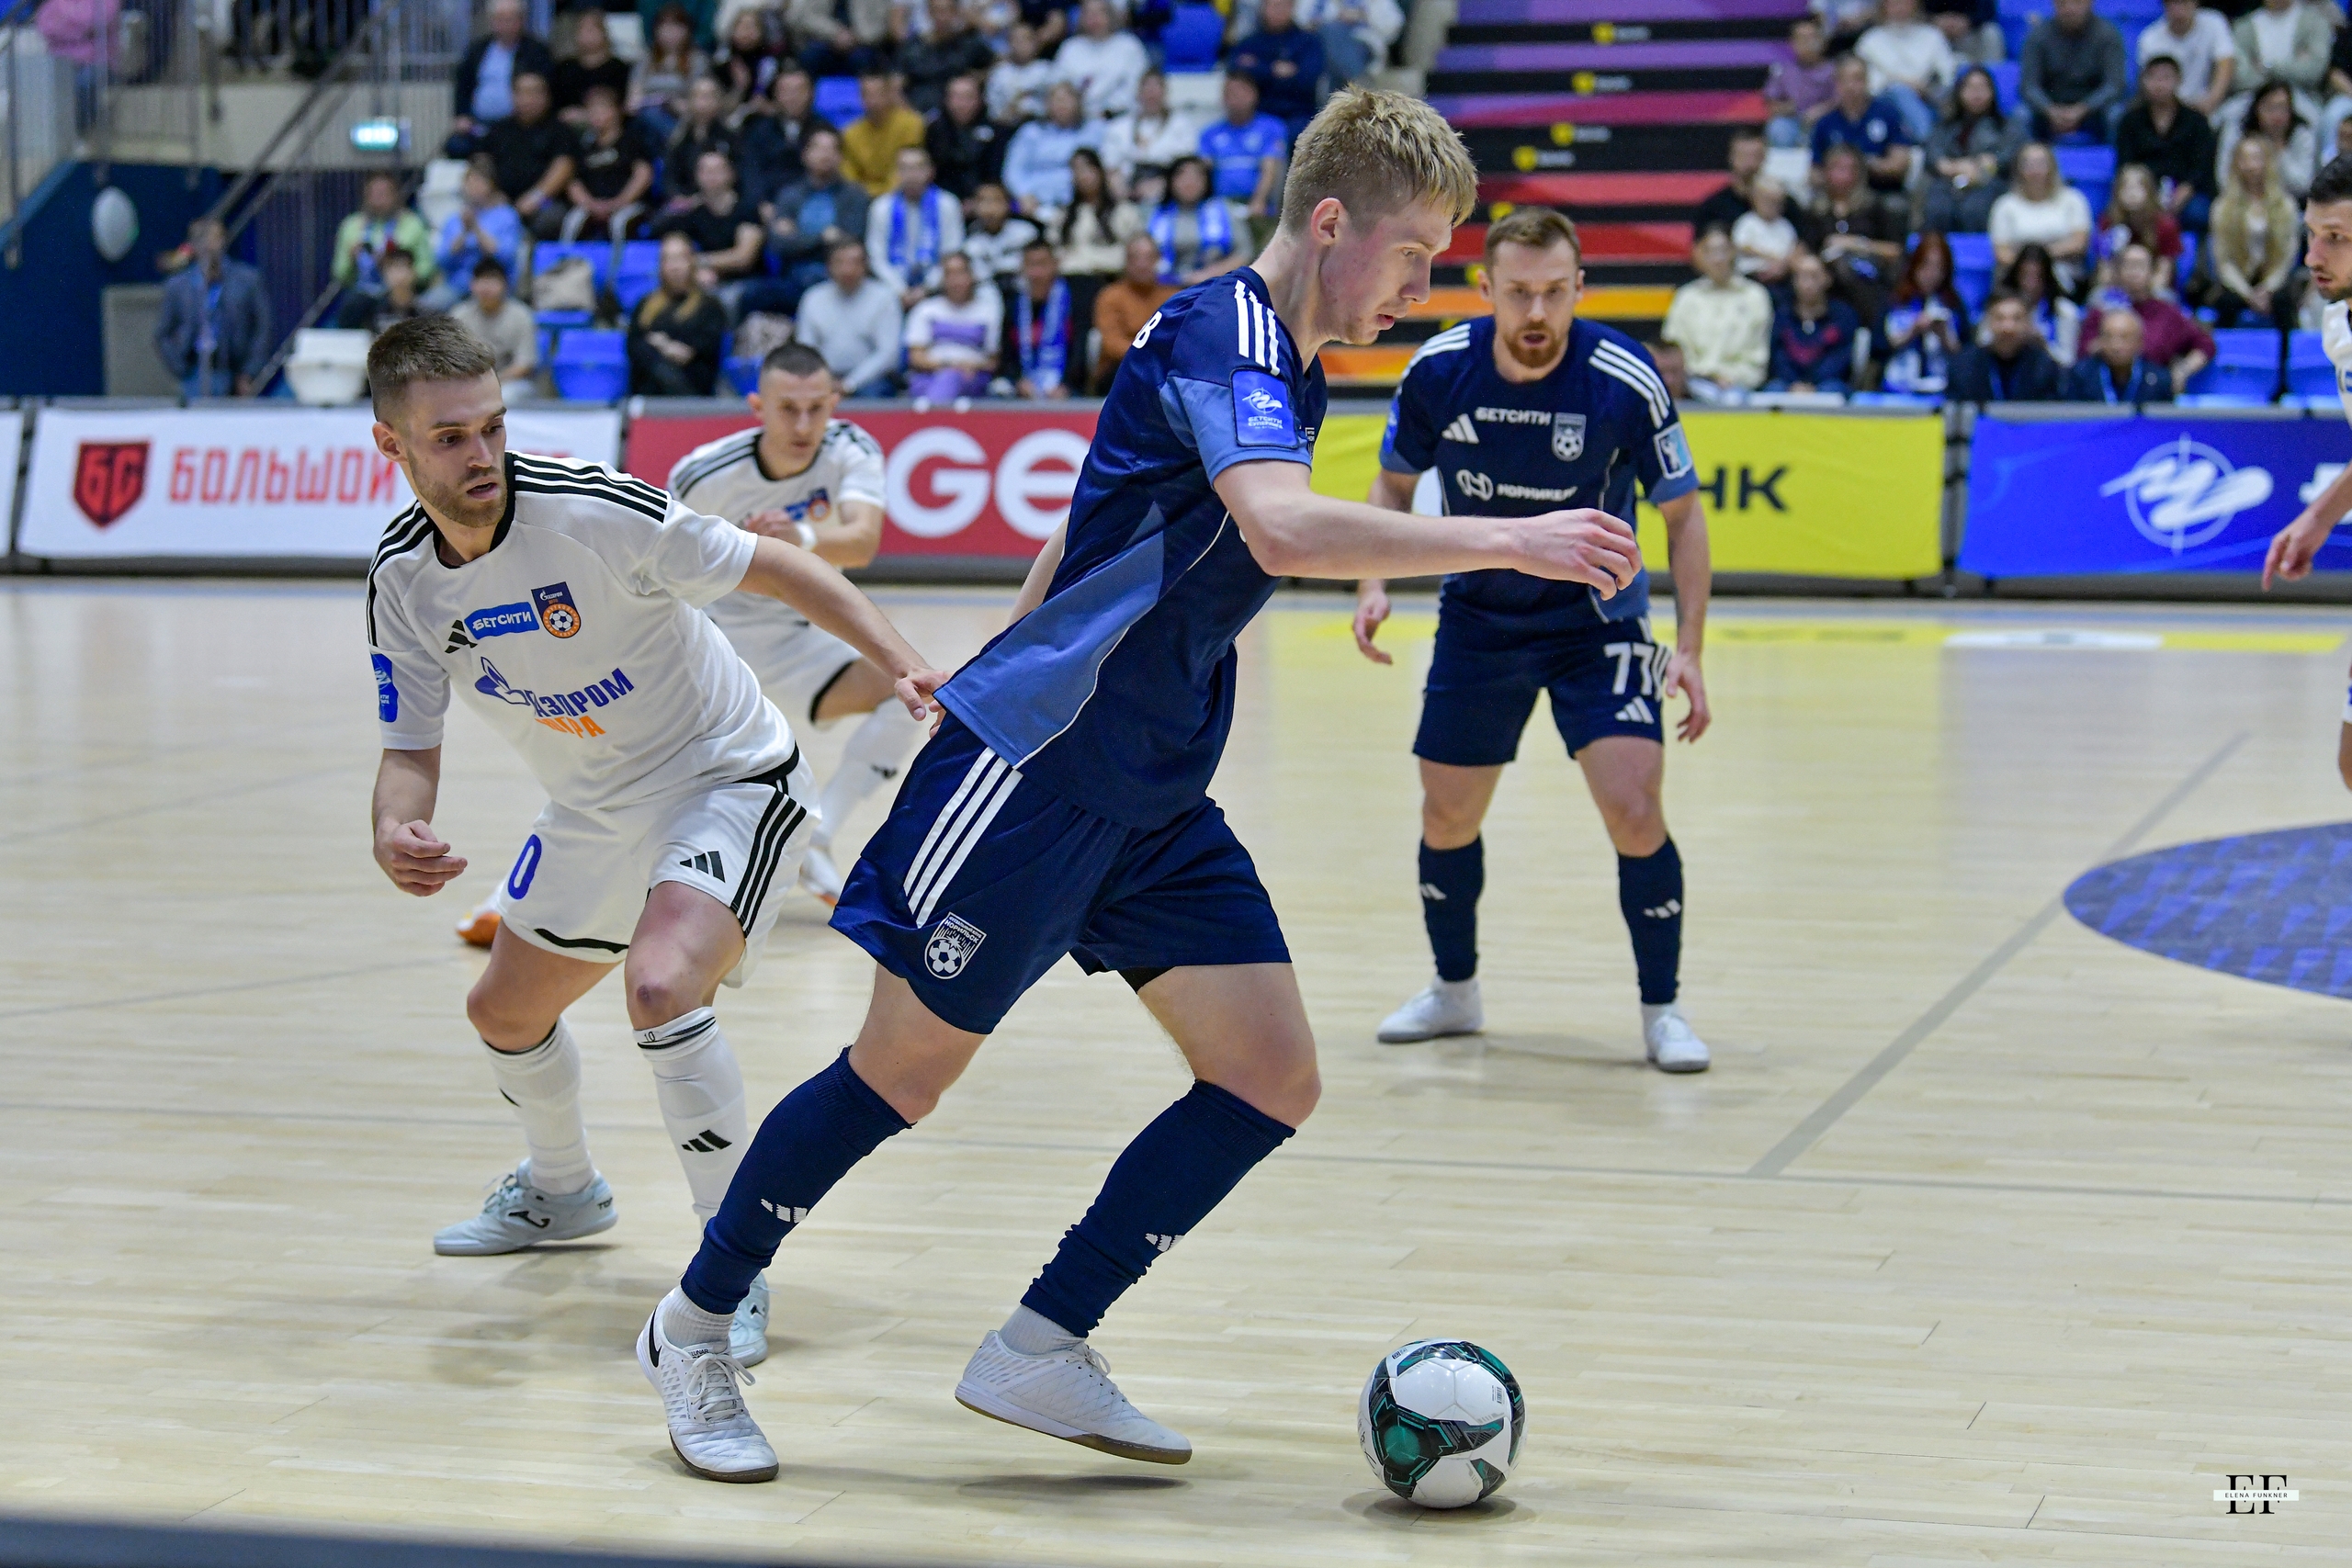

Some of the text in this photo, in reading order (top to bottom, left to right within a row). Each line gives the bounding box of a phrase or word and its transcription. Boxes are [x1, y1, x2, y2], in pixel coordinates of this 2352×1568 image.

[1474, 406, 1553, 427] БЕТСИТИ
[472, 611, 533, 632] БЕТСИТИ
[1602, 641, 1656, 696] 77
[944, 919, 980, 944] НОРИЛЬСК
[643, 1031, 656, 1043] 10
